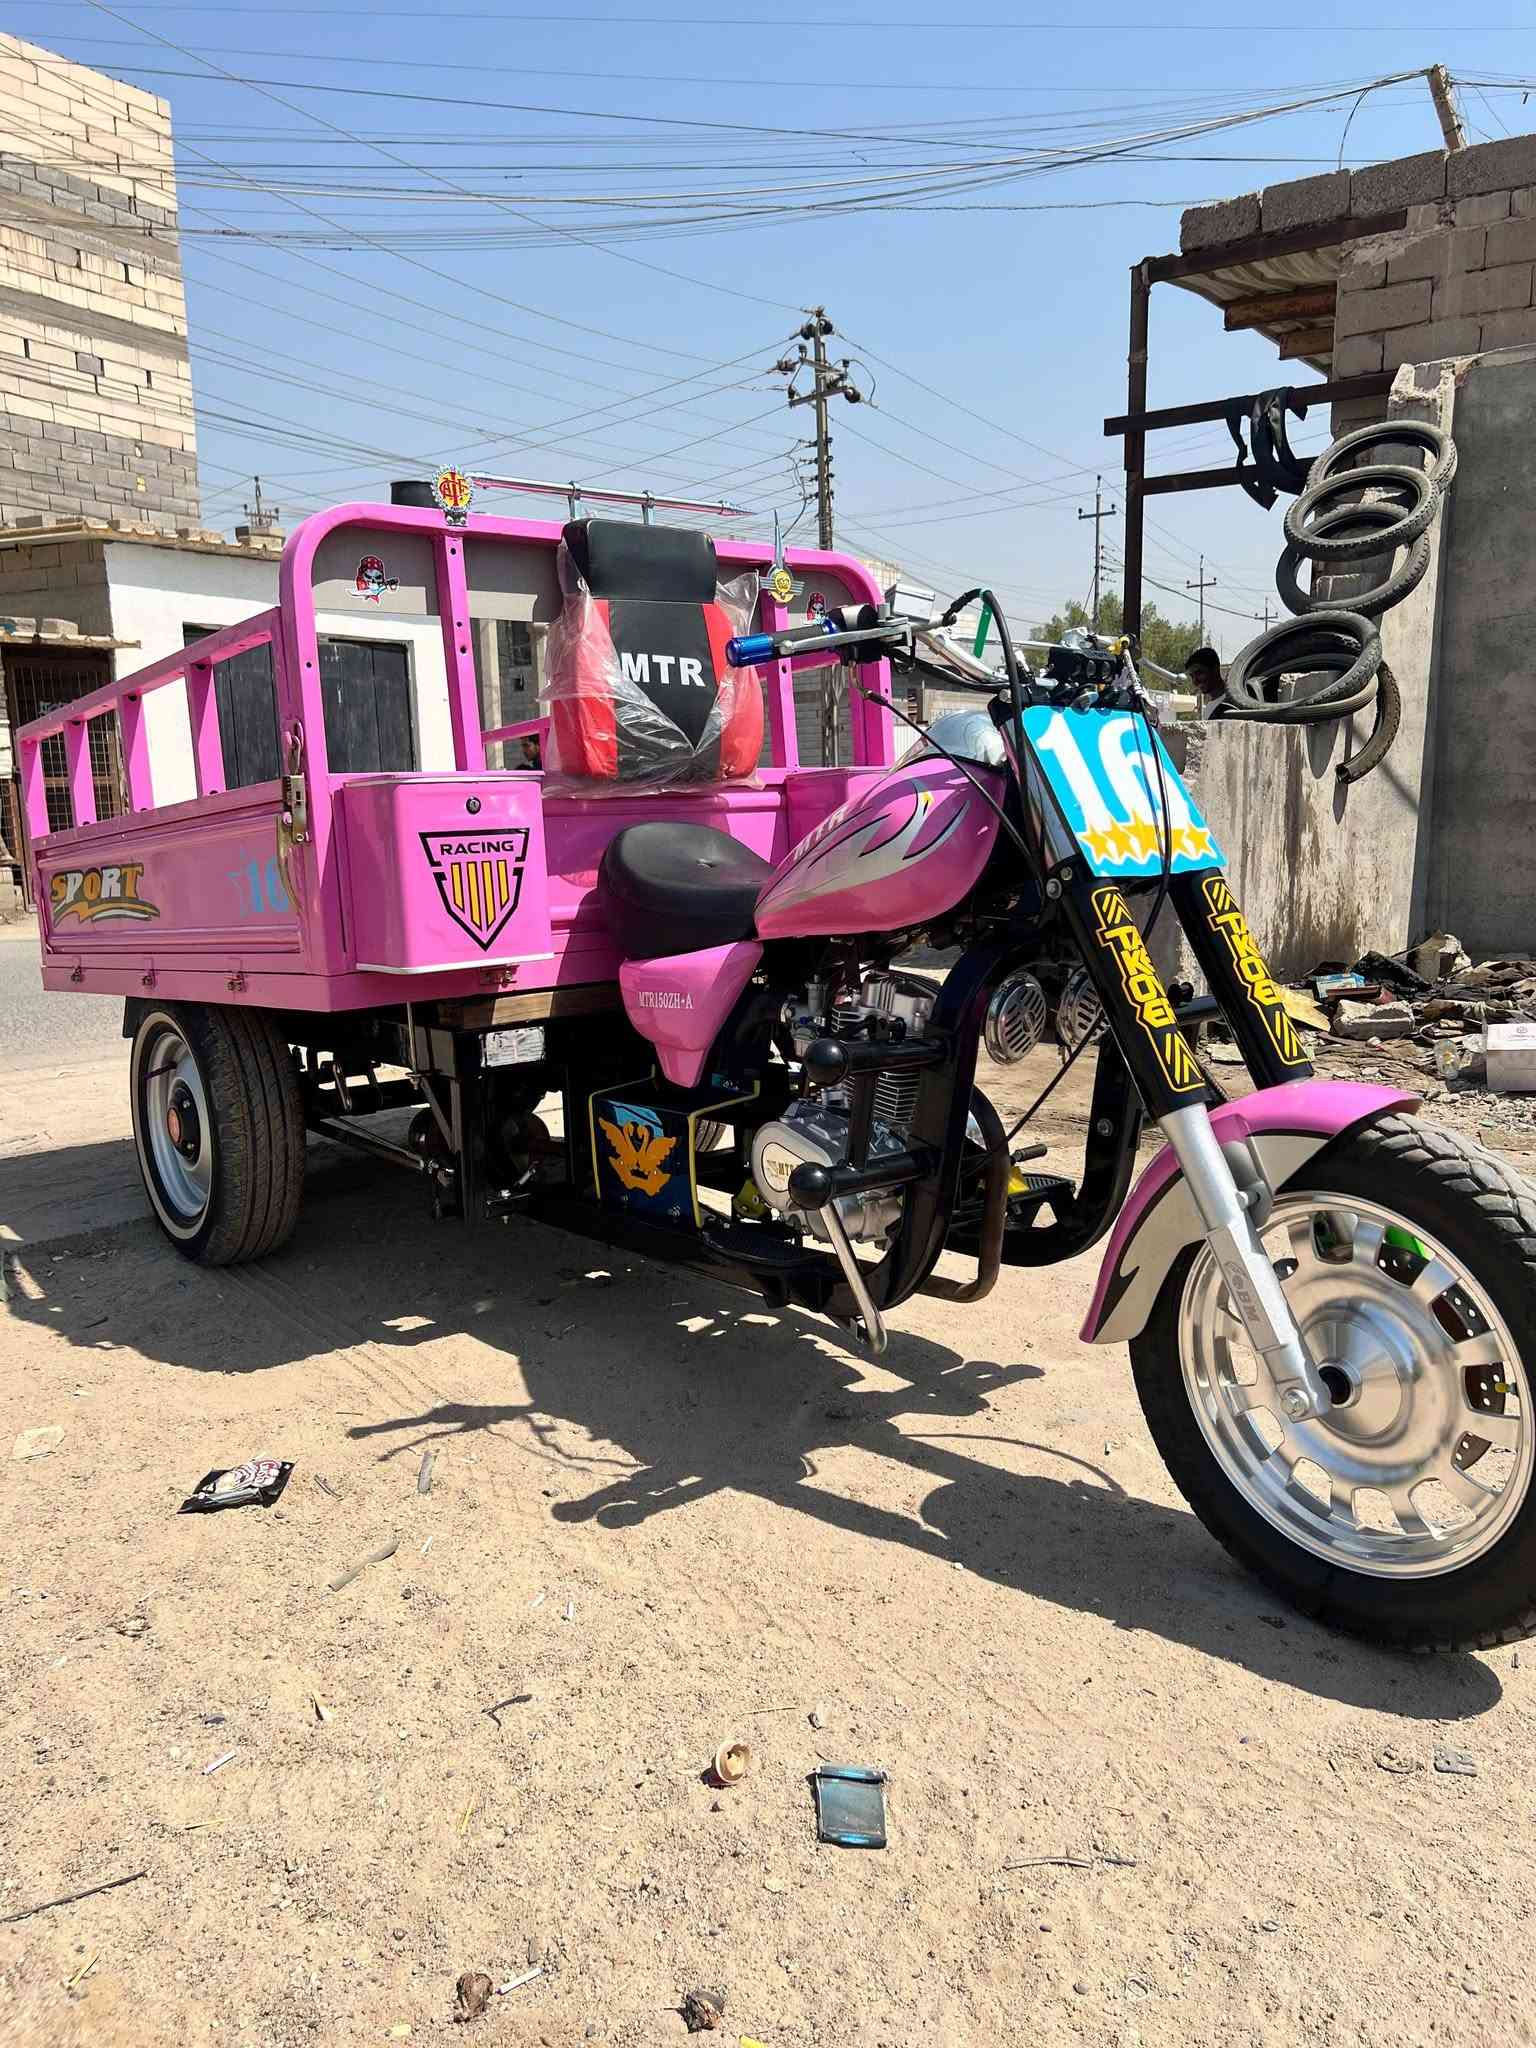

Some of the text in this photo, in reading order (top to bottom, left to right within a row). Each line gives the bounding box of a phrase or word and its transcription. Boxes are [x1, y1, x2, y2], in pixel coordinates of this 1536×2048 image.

[620, 652, 706, 688] MTR
[1036, 712, 1191, 837] 16
[440, 840, 515, 856] RACING
[51, 863, 145, 904] SPORT
